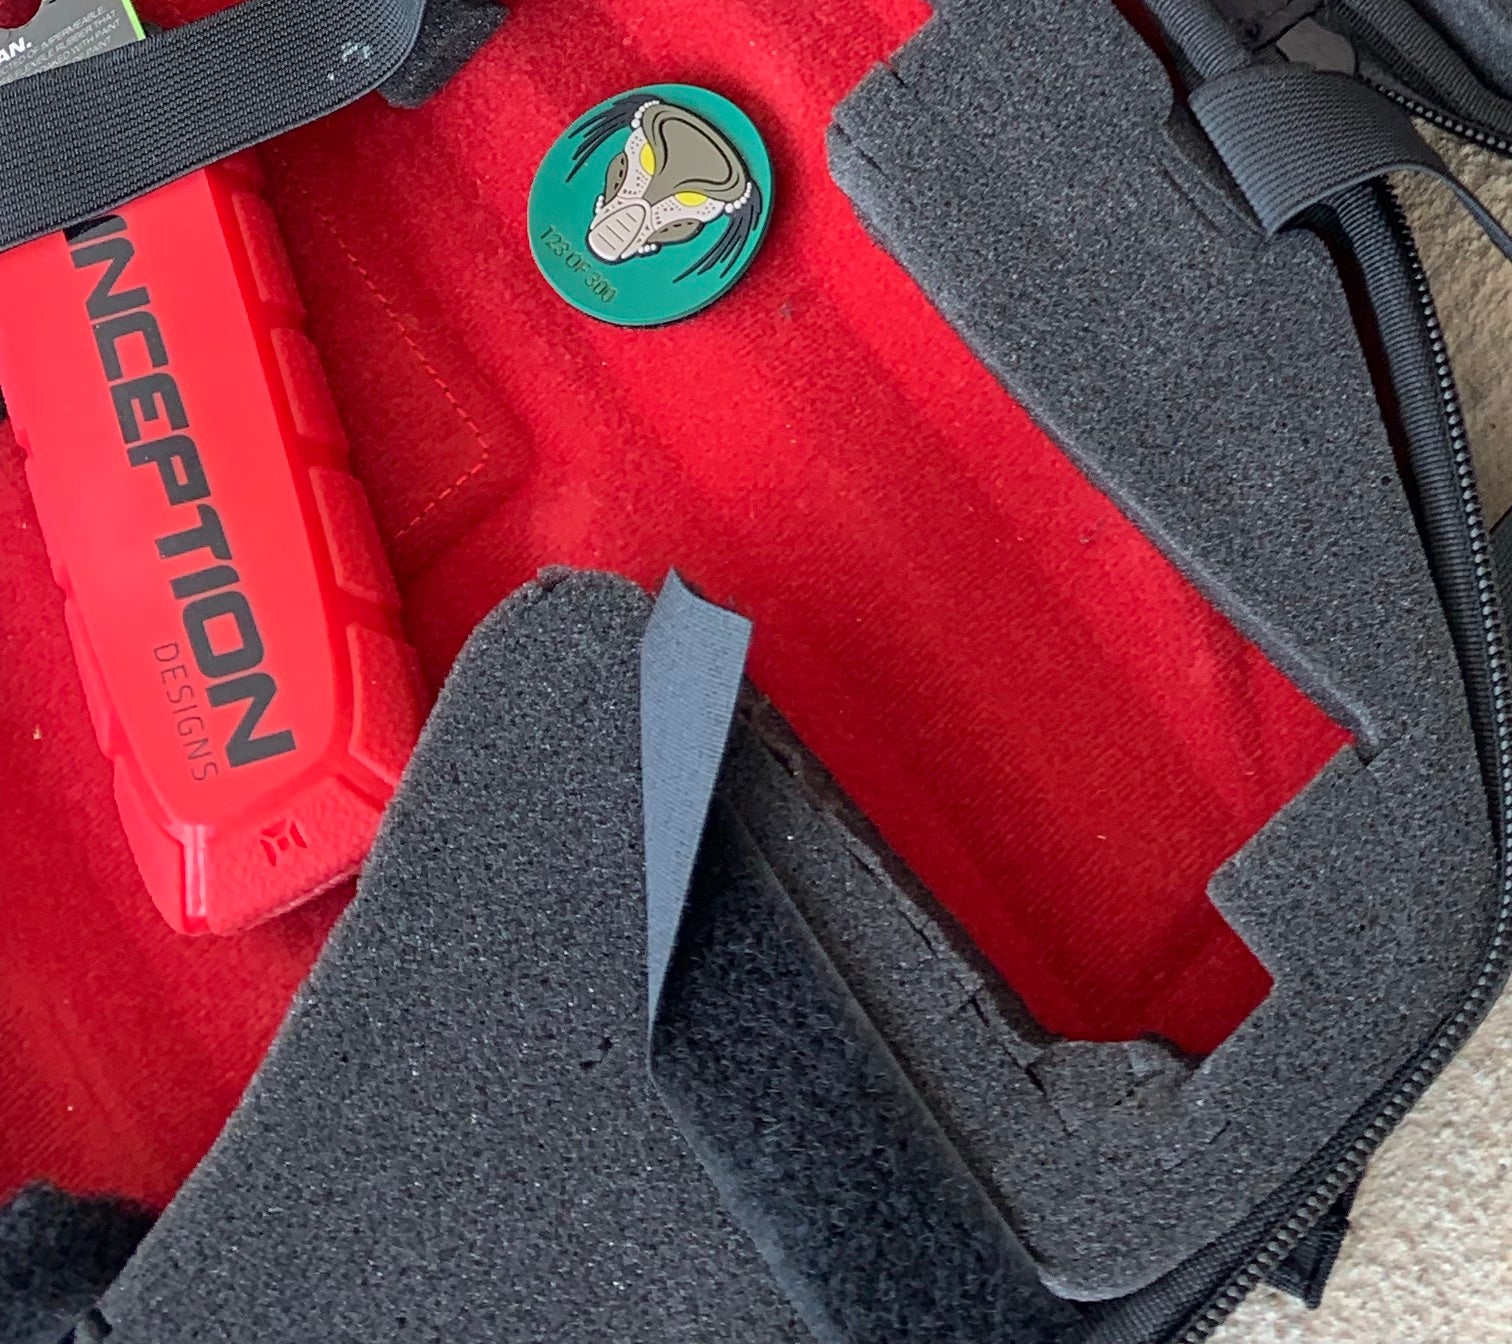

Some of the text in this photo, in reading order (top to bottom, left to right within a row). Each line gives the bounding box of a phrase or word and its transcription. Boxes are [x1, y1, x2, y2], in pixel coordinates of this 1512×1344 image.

[54, 24, 92, 53] RUBBER
[94, 9, 116, 28] THAT
[71, 34, 94, 54] WITH
[95, 17, 120, 39] PAINT
[540, 223, 618, 303] 123 OF 300
[63, 214, 297, 769] INCEPTION
[153, 641, 219, 781] DESIGNS
